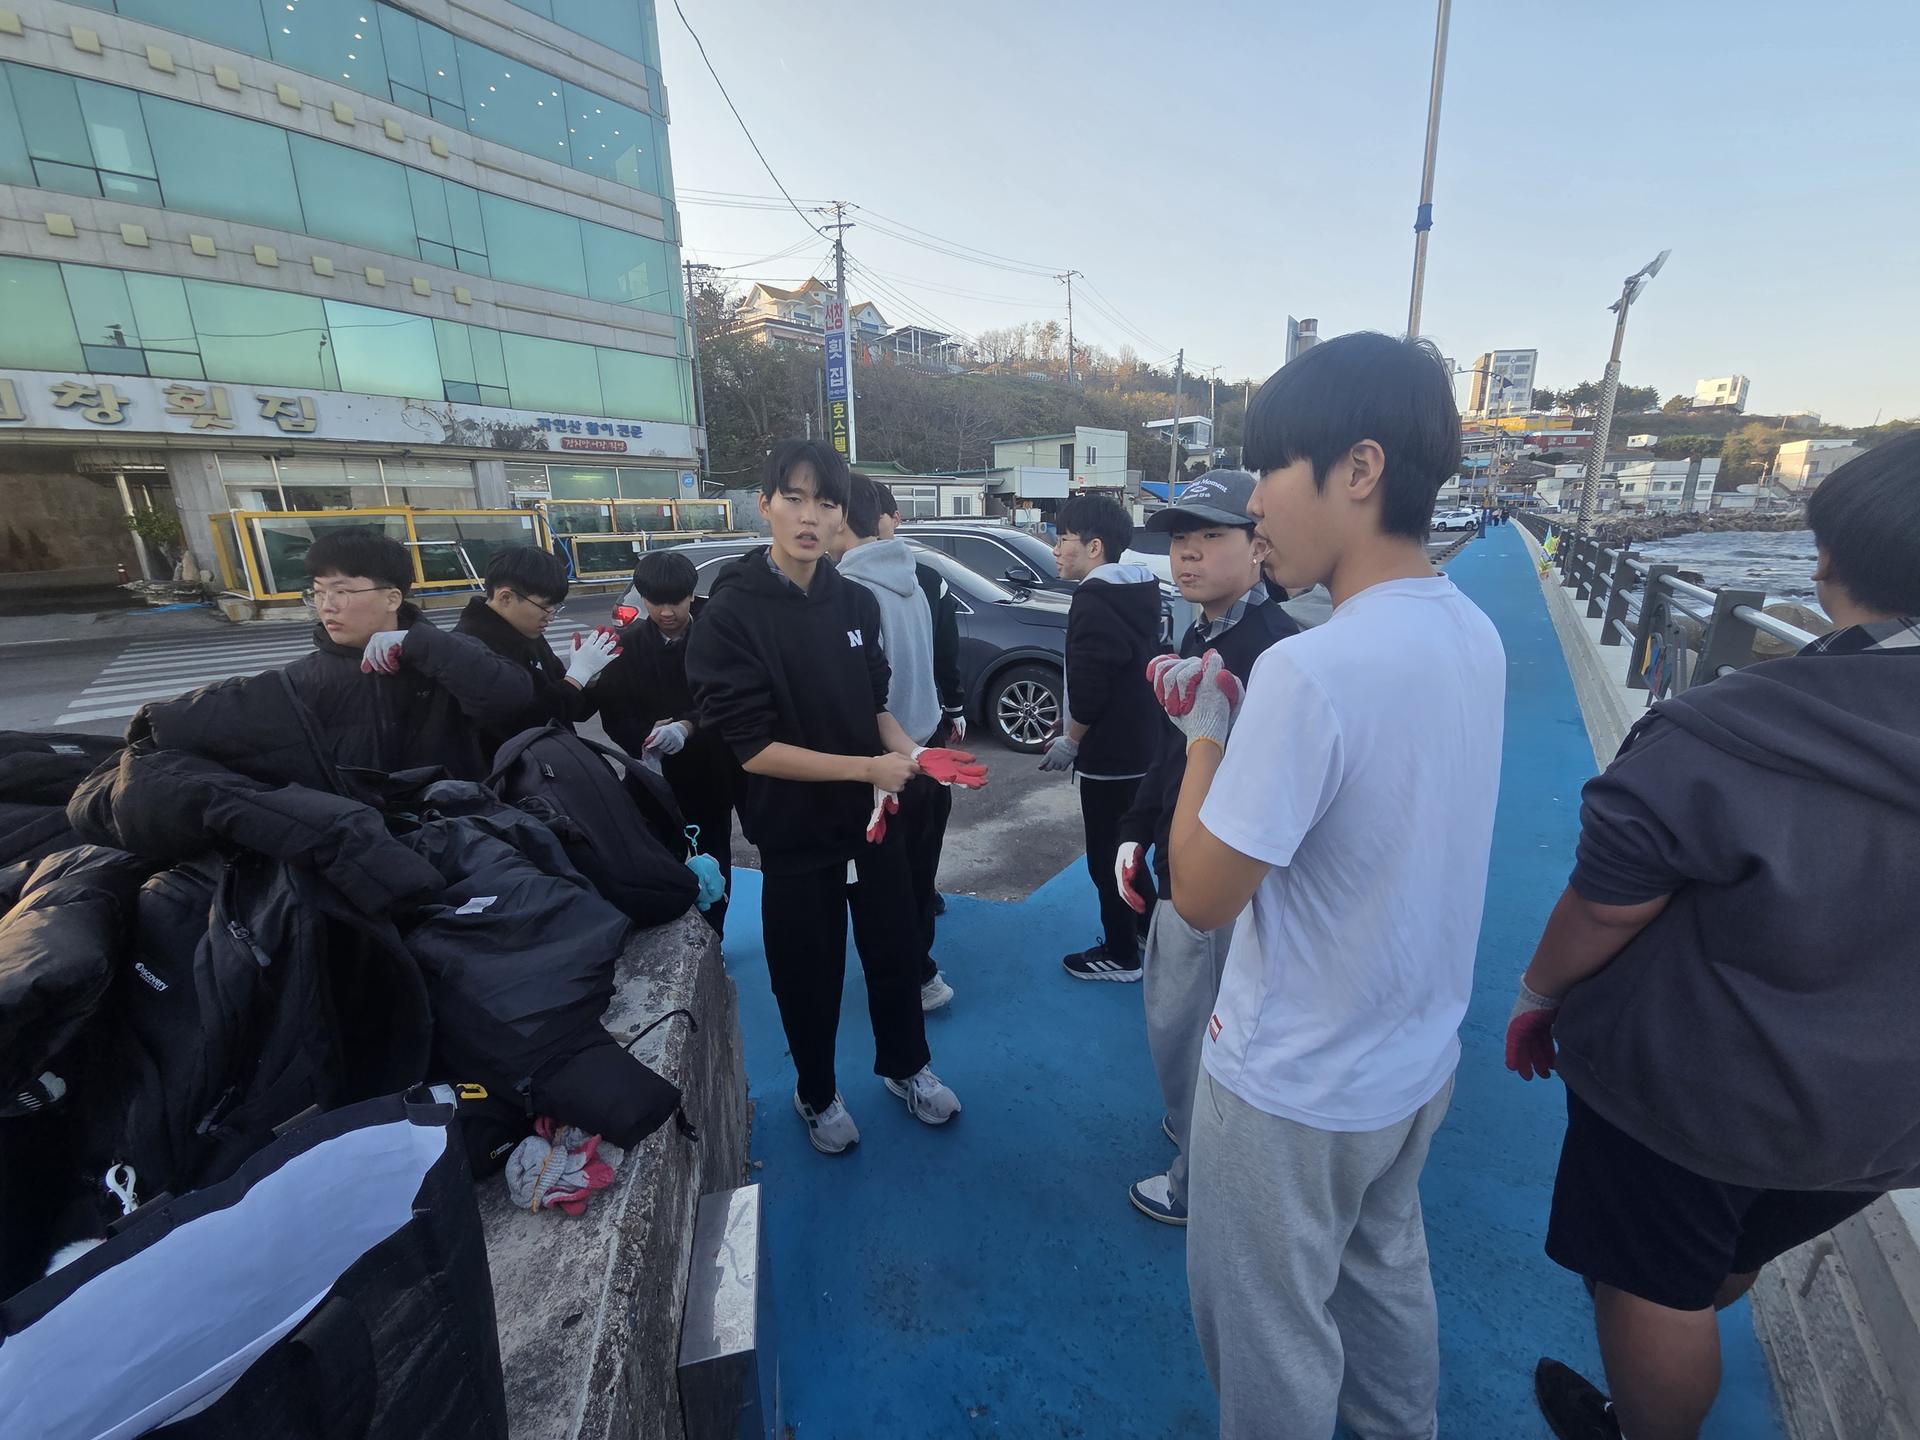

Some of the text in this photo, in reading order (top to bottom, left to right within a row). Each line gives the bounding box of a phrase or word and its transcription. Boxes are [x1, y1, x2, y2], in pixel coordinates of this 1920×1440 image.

[825, 303, 844, 330] 선창
[585, 421, 614, 436] 활어
[616, 424, 643, 438] 전문
[833, 402, 846, 452] 호스텔
[847, 629, 863, 648] N
